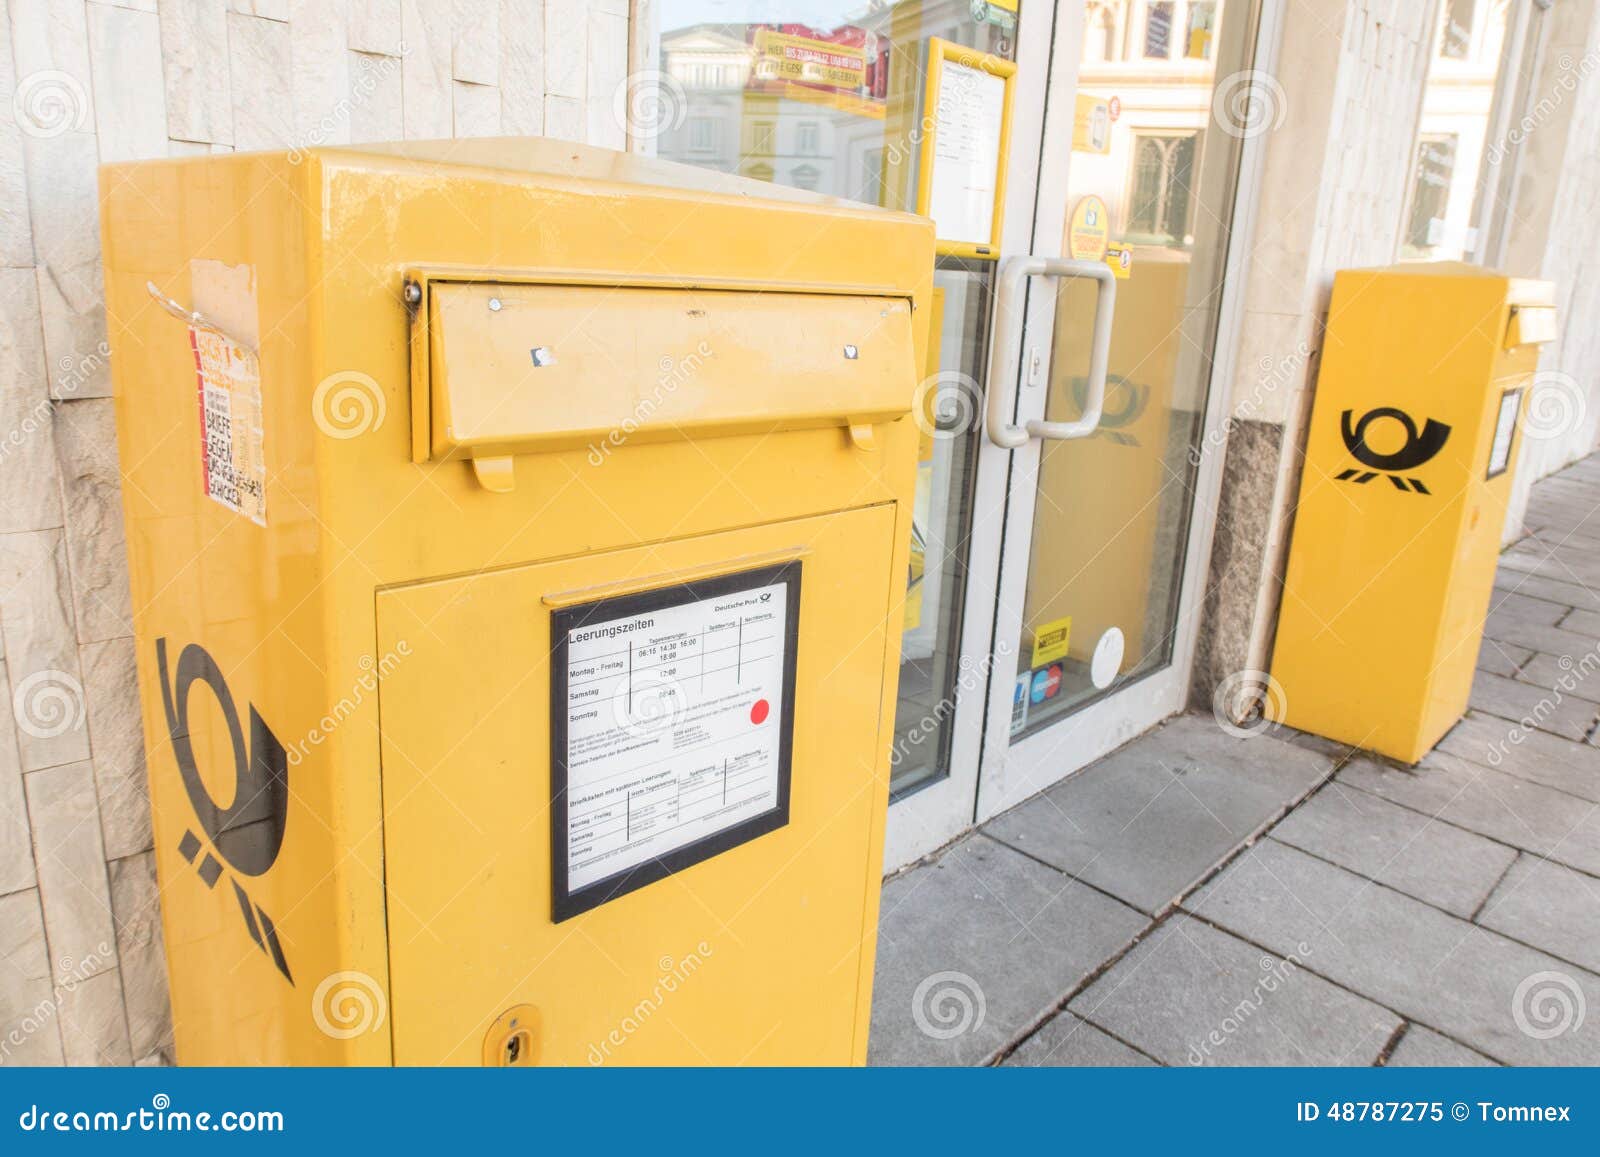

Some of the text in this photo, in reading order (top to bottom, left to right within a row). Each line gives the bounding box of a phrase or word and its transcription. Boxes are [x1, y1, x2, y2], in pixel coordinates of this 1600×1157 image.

[714, 598, 759, 612] Deutsche Post
[569, 618, 654, 645] Leerungszeiten
[638, 647, 657, 658] 06:15
[660, 642, 677, 652] 14:30
[569, 667, 595, 679] Montag
[600, 661, 624, 672] Freitag
[569, 688, 599, 701] Samstag
[569, 711, 598, 723] Sonntag
